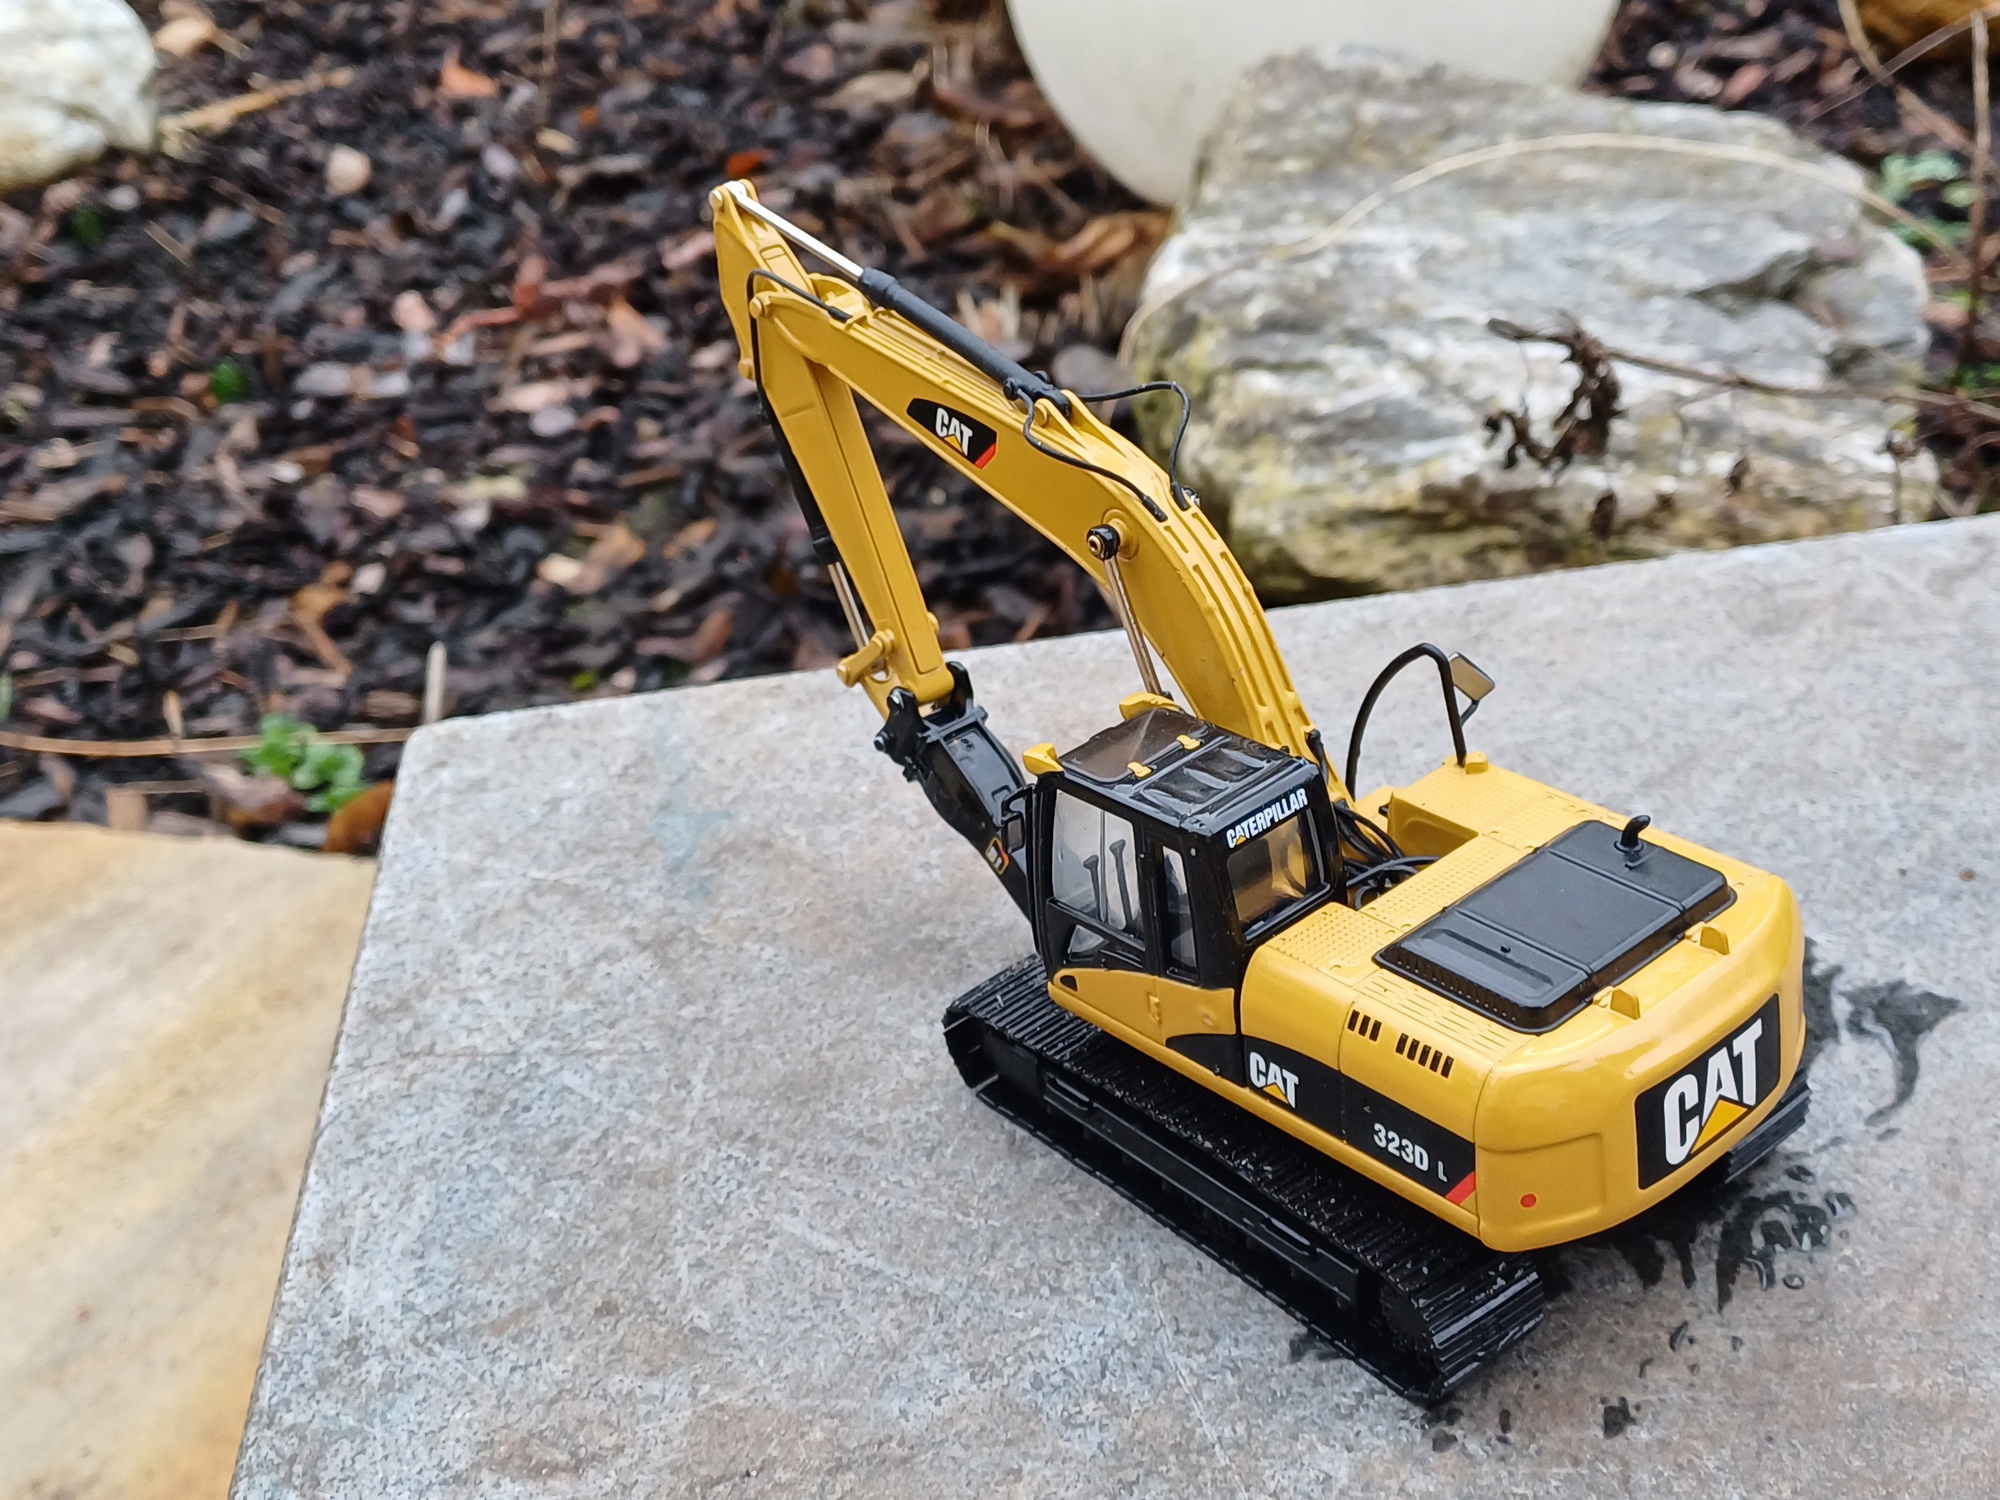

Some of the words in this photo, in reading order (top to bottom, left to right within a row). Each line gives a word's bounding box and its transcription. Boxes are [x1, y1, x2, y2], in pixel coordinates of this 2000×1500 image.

[935, 407, 973, 456] CAT
[1226, 788, 1308, 849] CATERPILLAR
[1250, 1051, 1299, 1108] CAT
[1663, 1017, 1762, 1165] CAT
[1373, 1122, 1429, 1172] 323D
[1437, 1160, 1448, 1182] L
